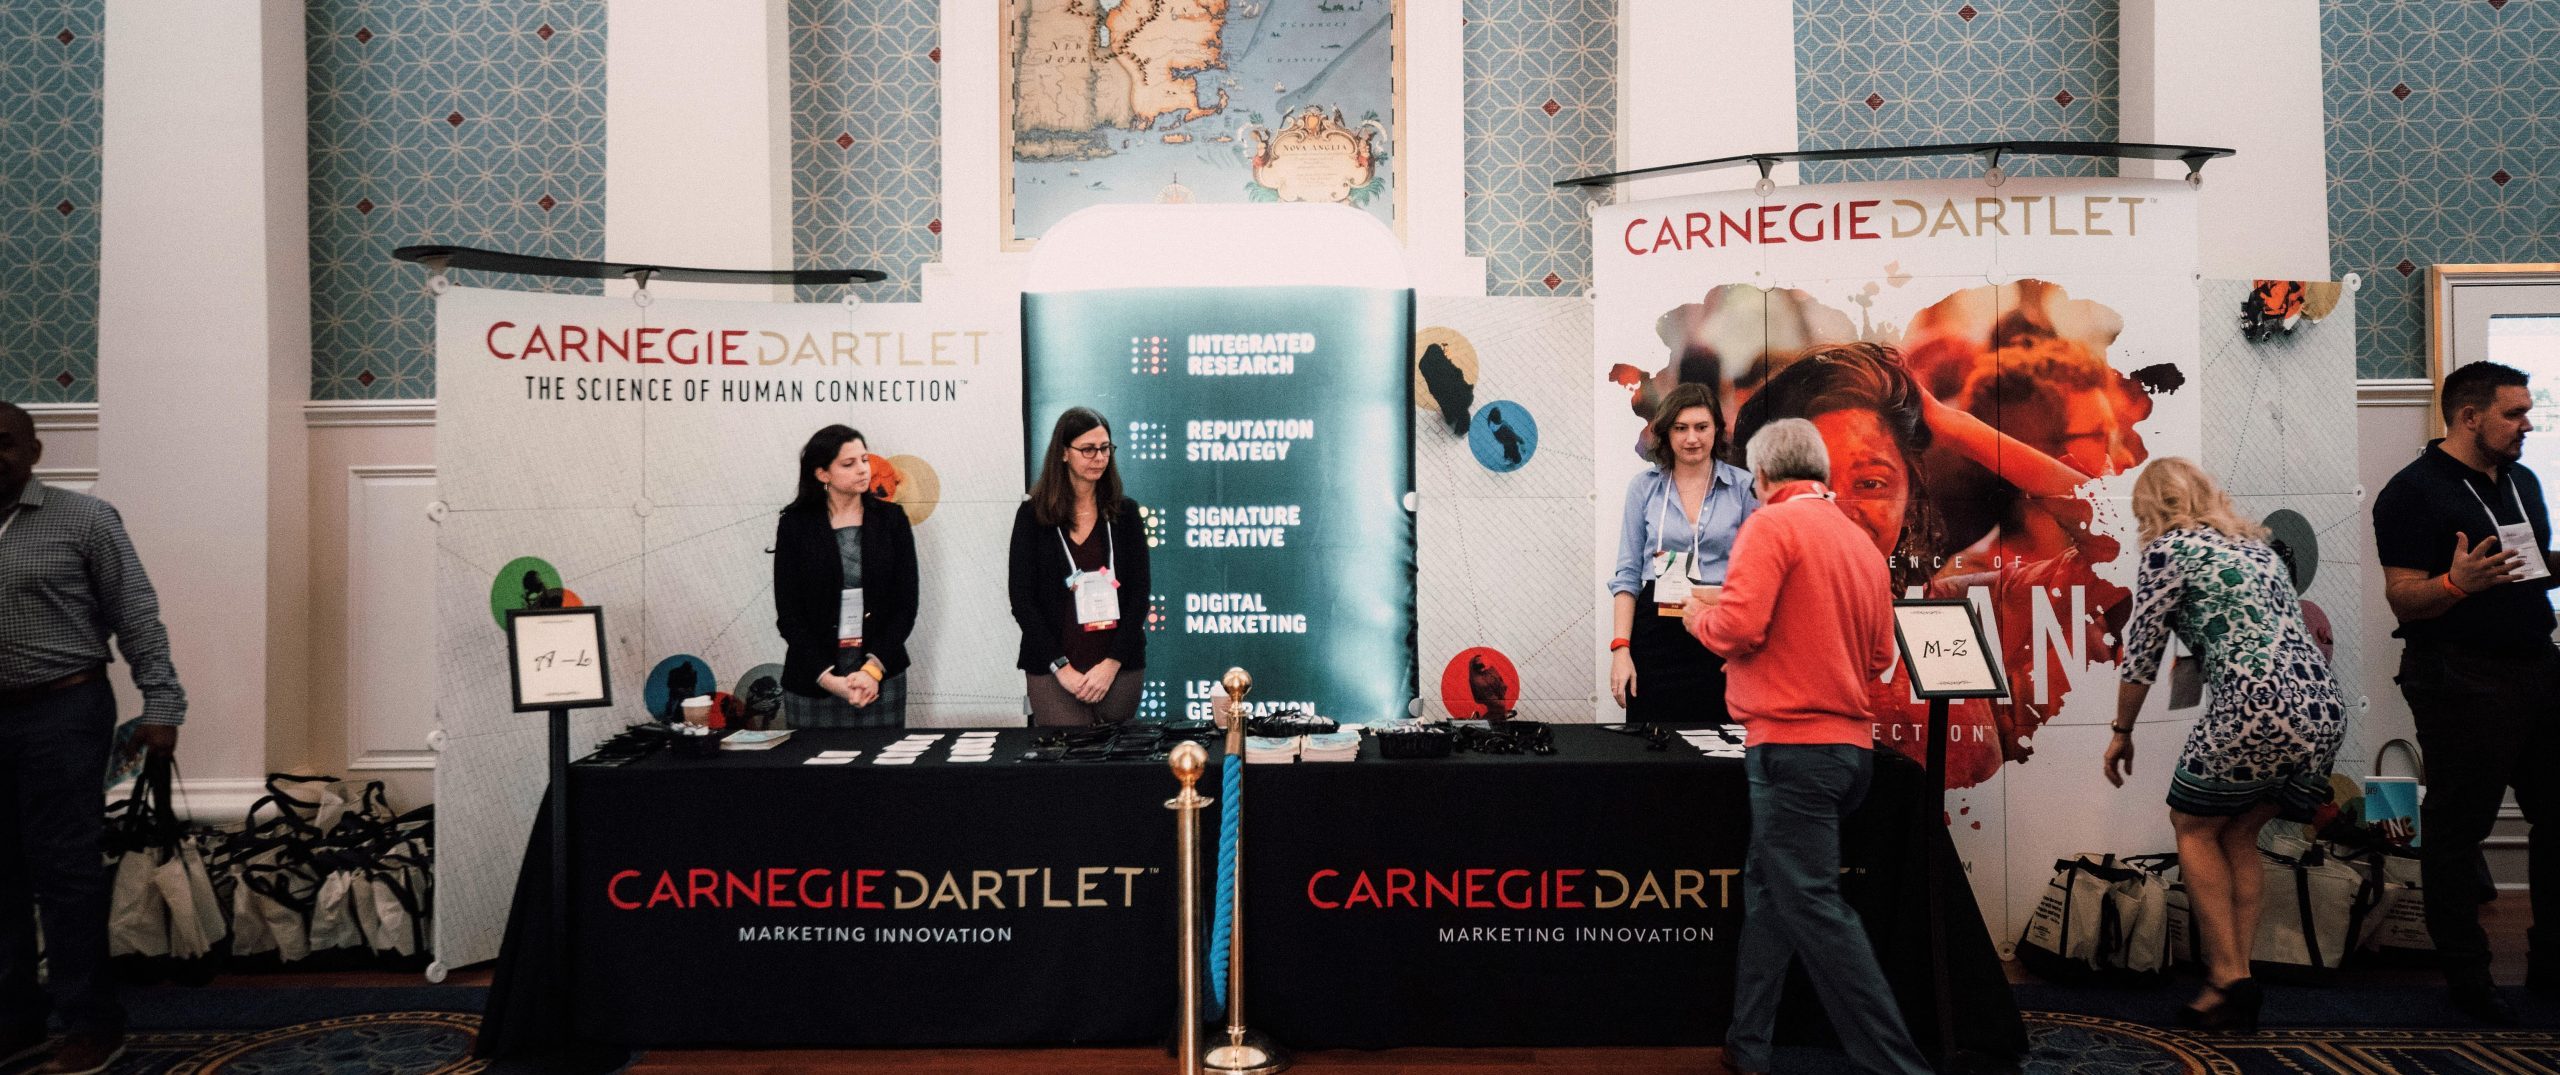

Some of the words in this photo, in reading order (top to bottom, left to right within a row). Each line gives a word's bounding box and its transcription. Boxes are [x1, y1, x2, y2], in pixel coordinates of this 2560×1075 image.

[1187, 333, 1316, 354] INTEGRATED
[1187, 354, 1295, 376] RESEARCH
[525, 375, 566, 400] THE
[577, 377, 673, 402] SCIENCE
[684, 379, 711, 402] OF
[722, 379, 803, 402] HUMAN
[1186, 419, 1315, 441] REPUTATION
[1185, 441, 1291, 462] STRATEGY
[1184, 505, 1301, 527] SIGNATURE
[1184, 526, 1286, 548] CREATIVE
[1993, 555, 2023, 569] OF
[1185, 593, 1268, 613] DIGITAL
[1185, 613, 1308, 634] MARKETING
[738, 925, 866, 943] MARKETING
[874, 926, 1013, 943] INNOVATION
[1439, 926, 1566, 943] MARKETING
[1575, 926, 1715, 943] INNOVATION
